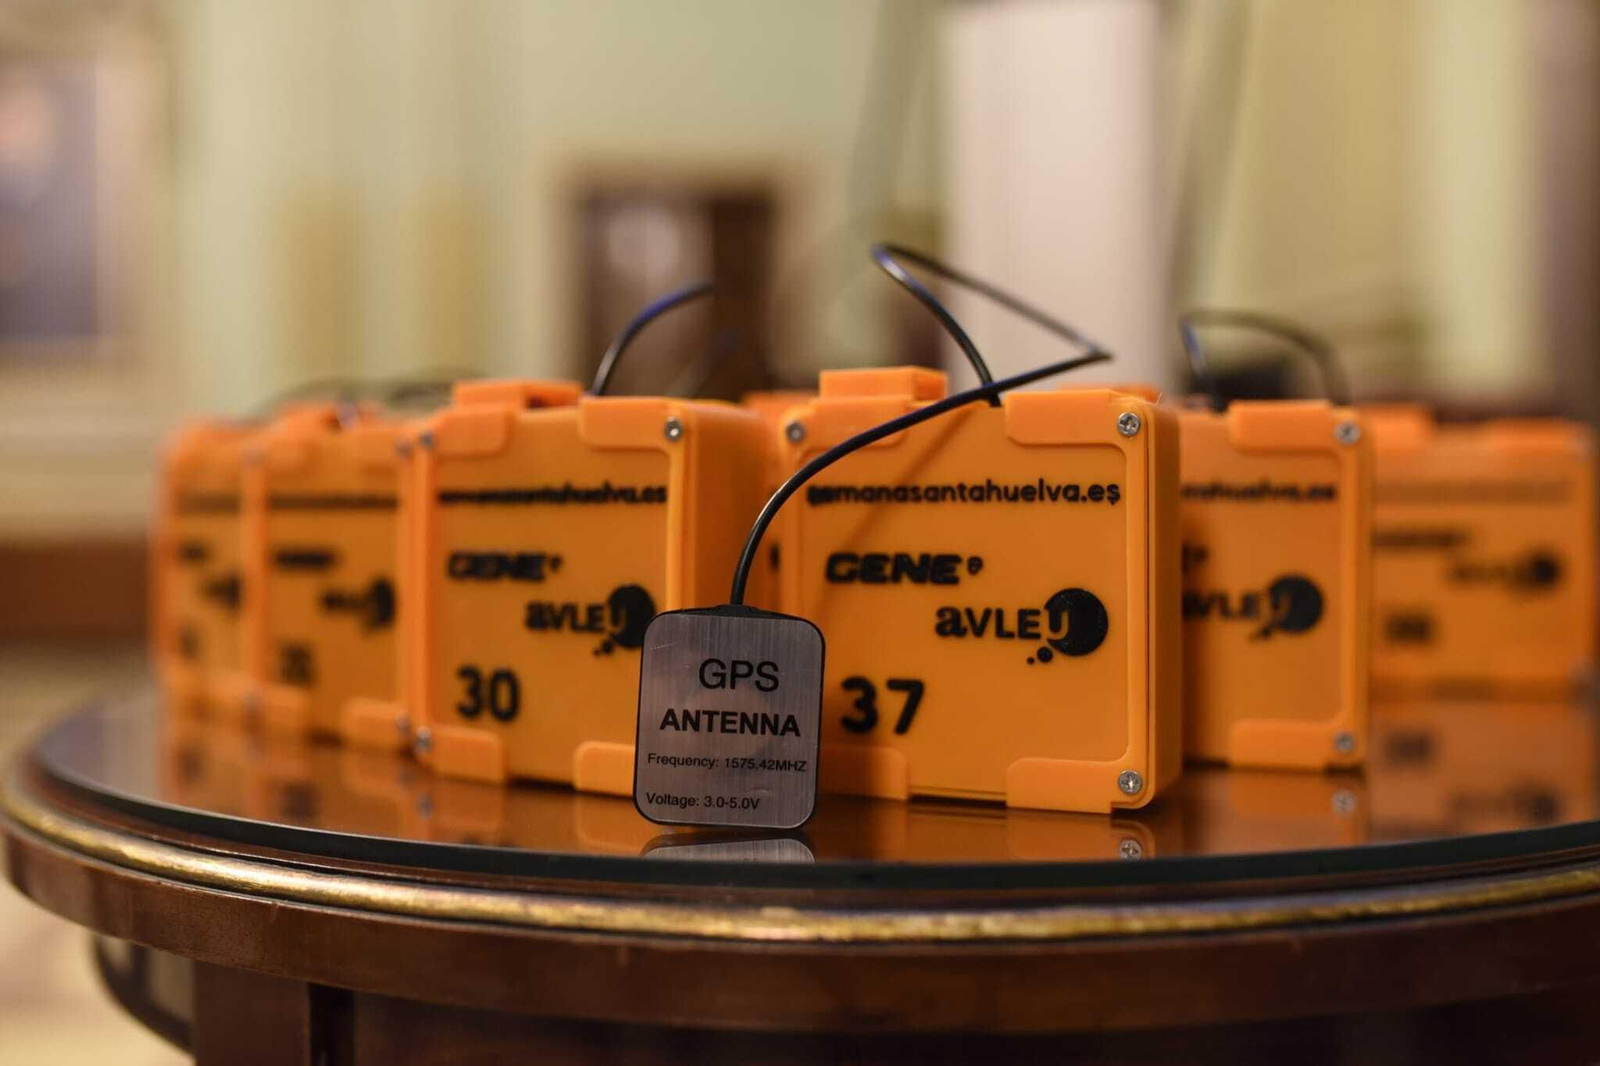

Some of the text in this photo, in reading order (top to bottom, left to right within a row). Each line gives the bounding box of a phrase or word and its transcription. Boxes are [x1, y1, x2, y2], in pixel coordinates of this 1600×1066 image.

[699, 658, 779, 692] GPS
[455, 664, 521, 723] 30
[840, 676, 926, 735] 37
[659, 708, 801, 737] ANTENNA
[647, 753, 807, 772] Frequency: 1575.42MHZ
[646, 792, 760, 810] Voltage: 3.0-5.0V
